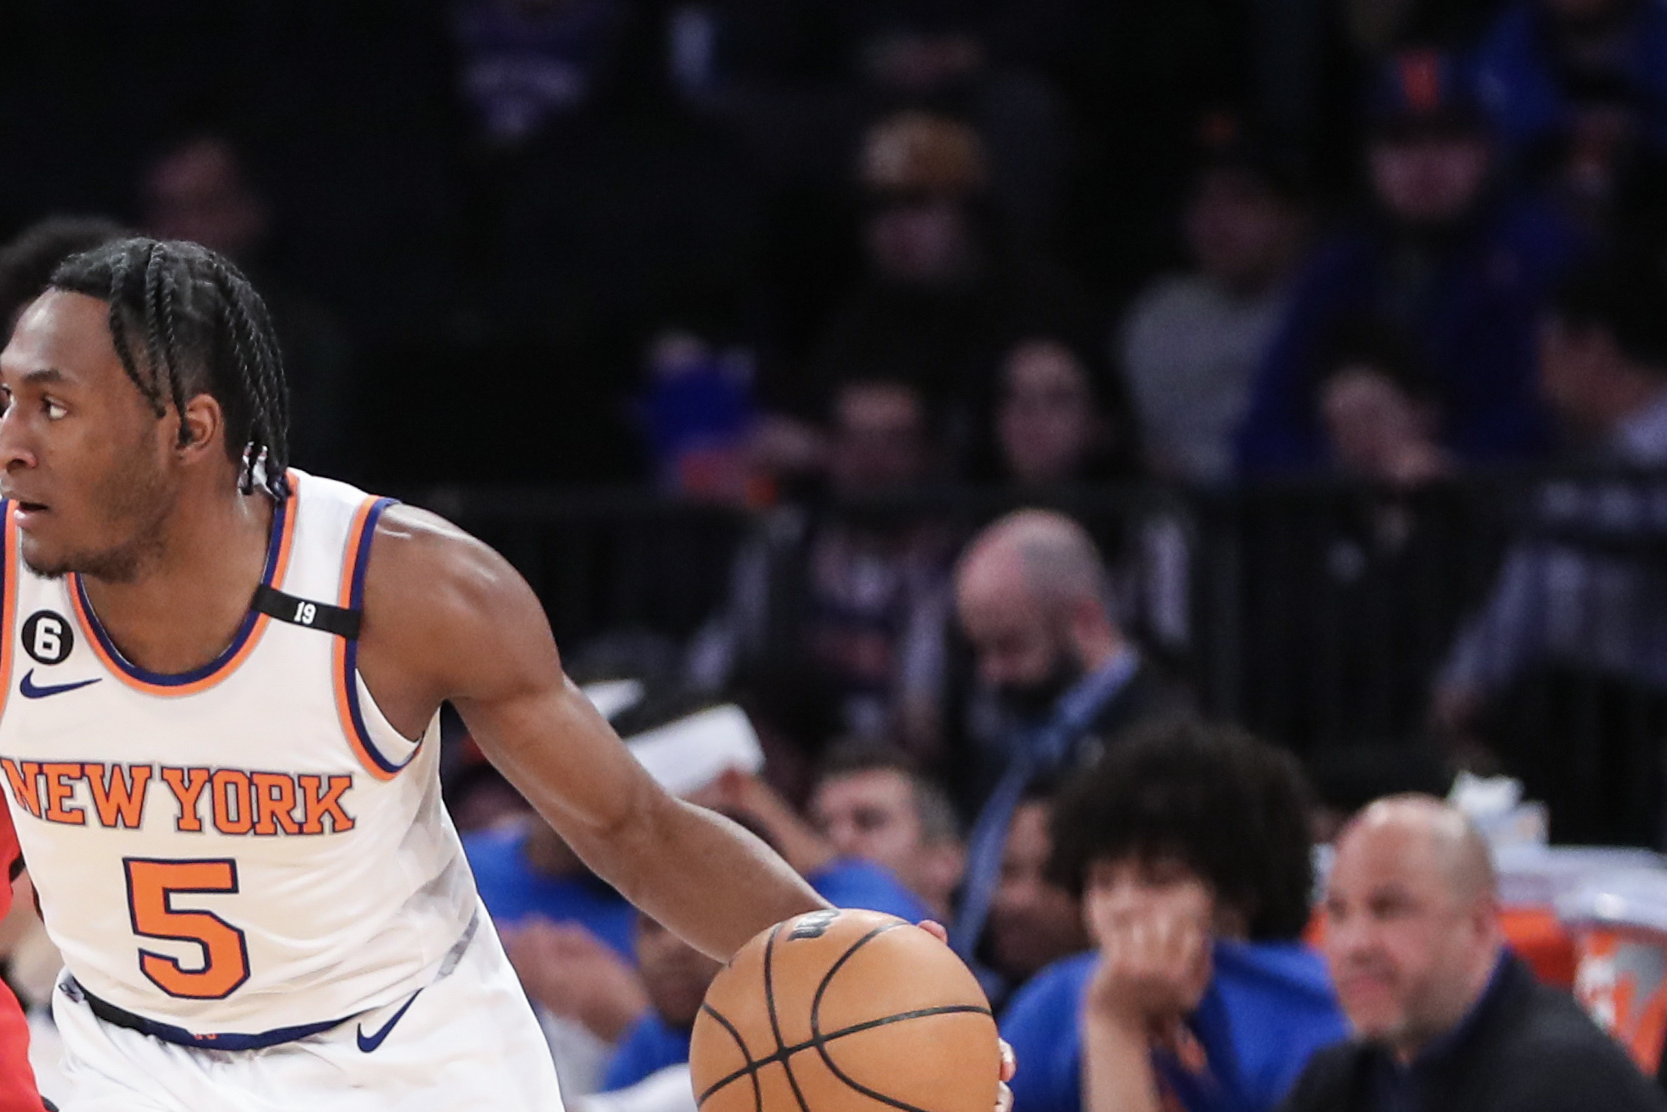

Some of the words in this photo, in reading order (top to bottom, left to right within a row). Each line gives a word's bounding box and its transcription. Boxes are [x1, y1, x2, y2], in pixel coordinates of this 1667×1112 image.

[33, 616, 63, 660] 6
[293, 600, 317, 625] 19
[160, 766, 356, 836] YORK
[122, 856, 251, 1000] 5
